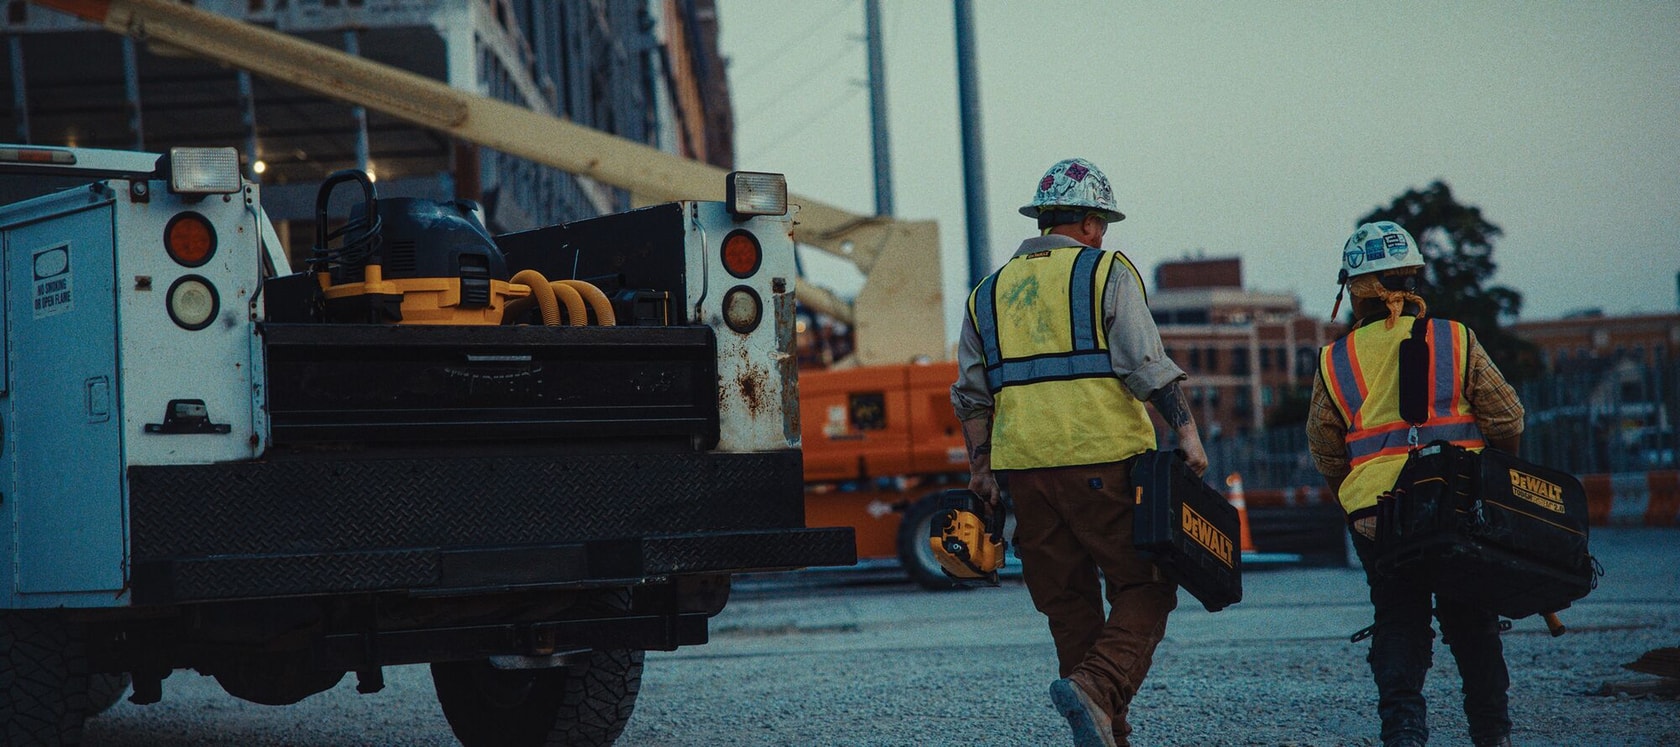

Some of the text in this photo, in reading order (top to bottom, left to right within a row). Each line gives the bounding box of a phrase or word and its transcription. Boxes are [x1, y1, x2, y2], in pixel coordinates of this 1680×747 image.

[37, 279, 66, 296] NO SMOKING
[34, 290, 70, 310] OR OPEN FLAME
